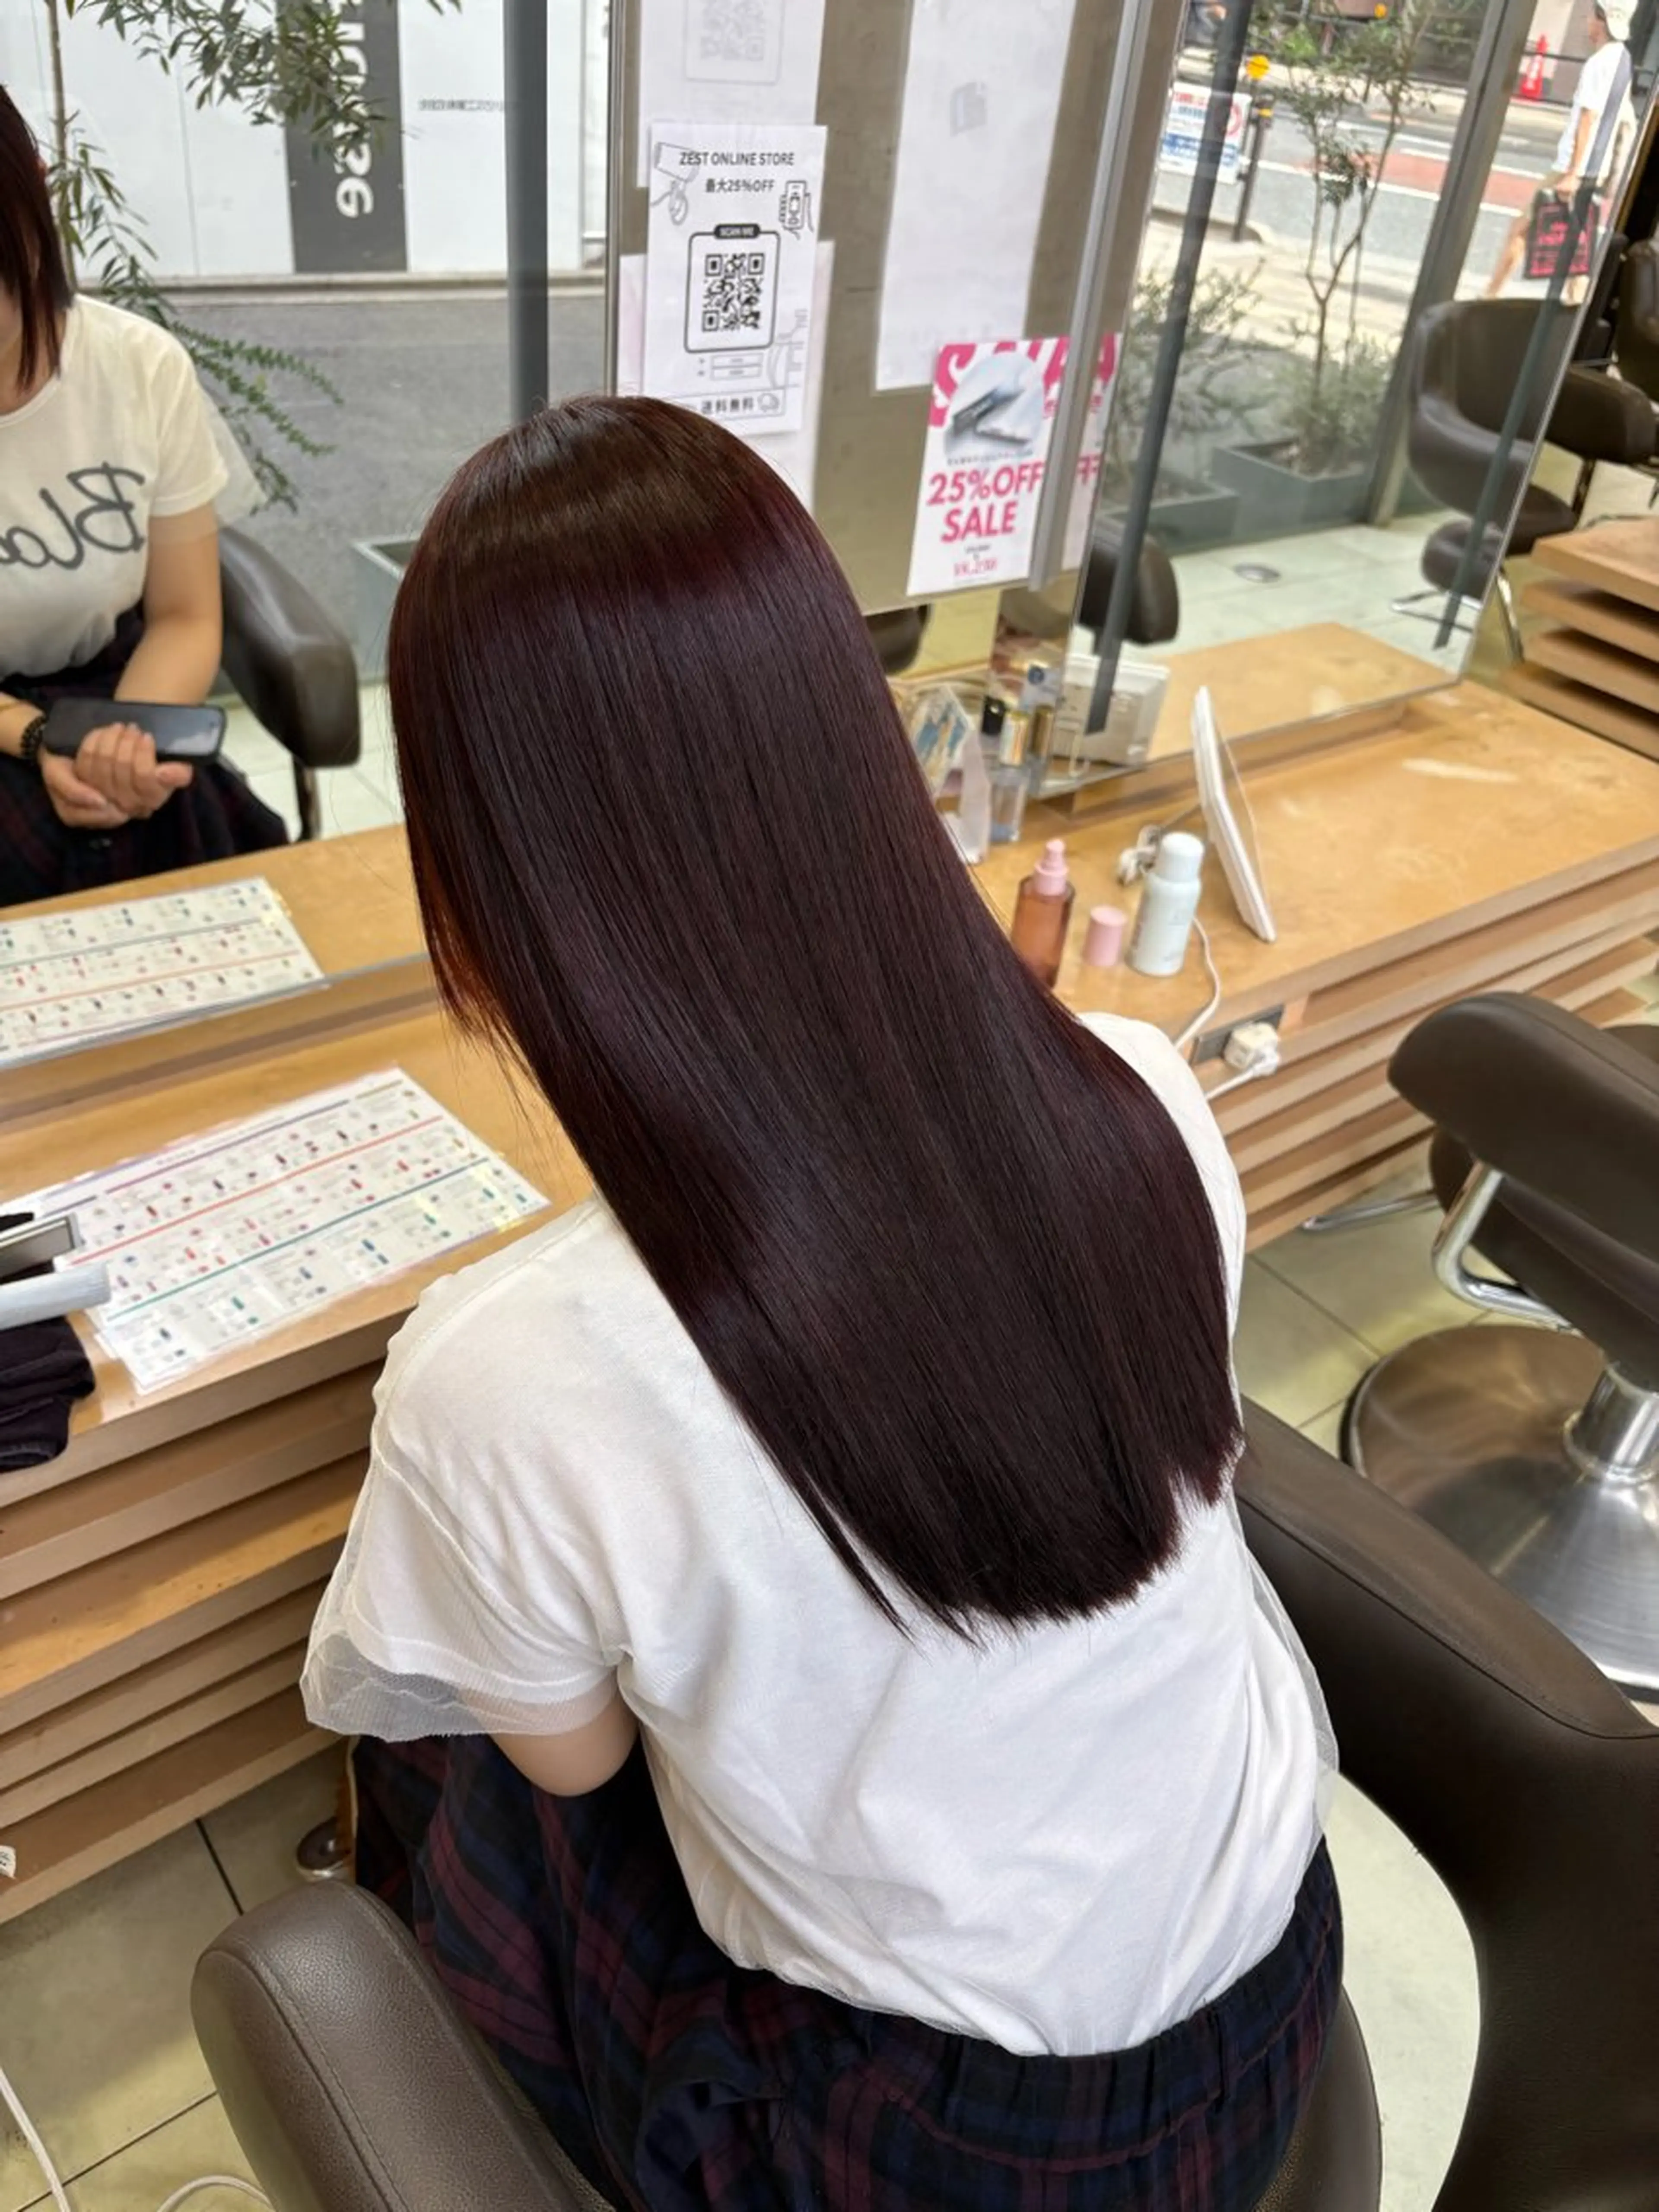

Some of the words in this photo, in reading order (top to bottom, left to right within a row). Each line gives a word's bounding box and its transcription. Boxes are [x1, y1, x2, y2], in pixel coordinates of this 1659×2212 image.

[679, 152, 709, 166] ZEST
[711, 152, 757, 166] ONLINE
[760, 152, 795, 166] STORE
[927, 461, 1045, 506] 25%OFF
[941, 500, 1019, 544] SALE
